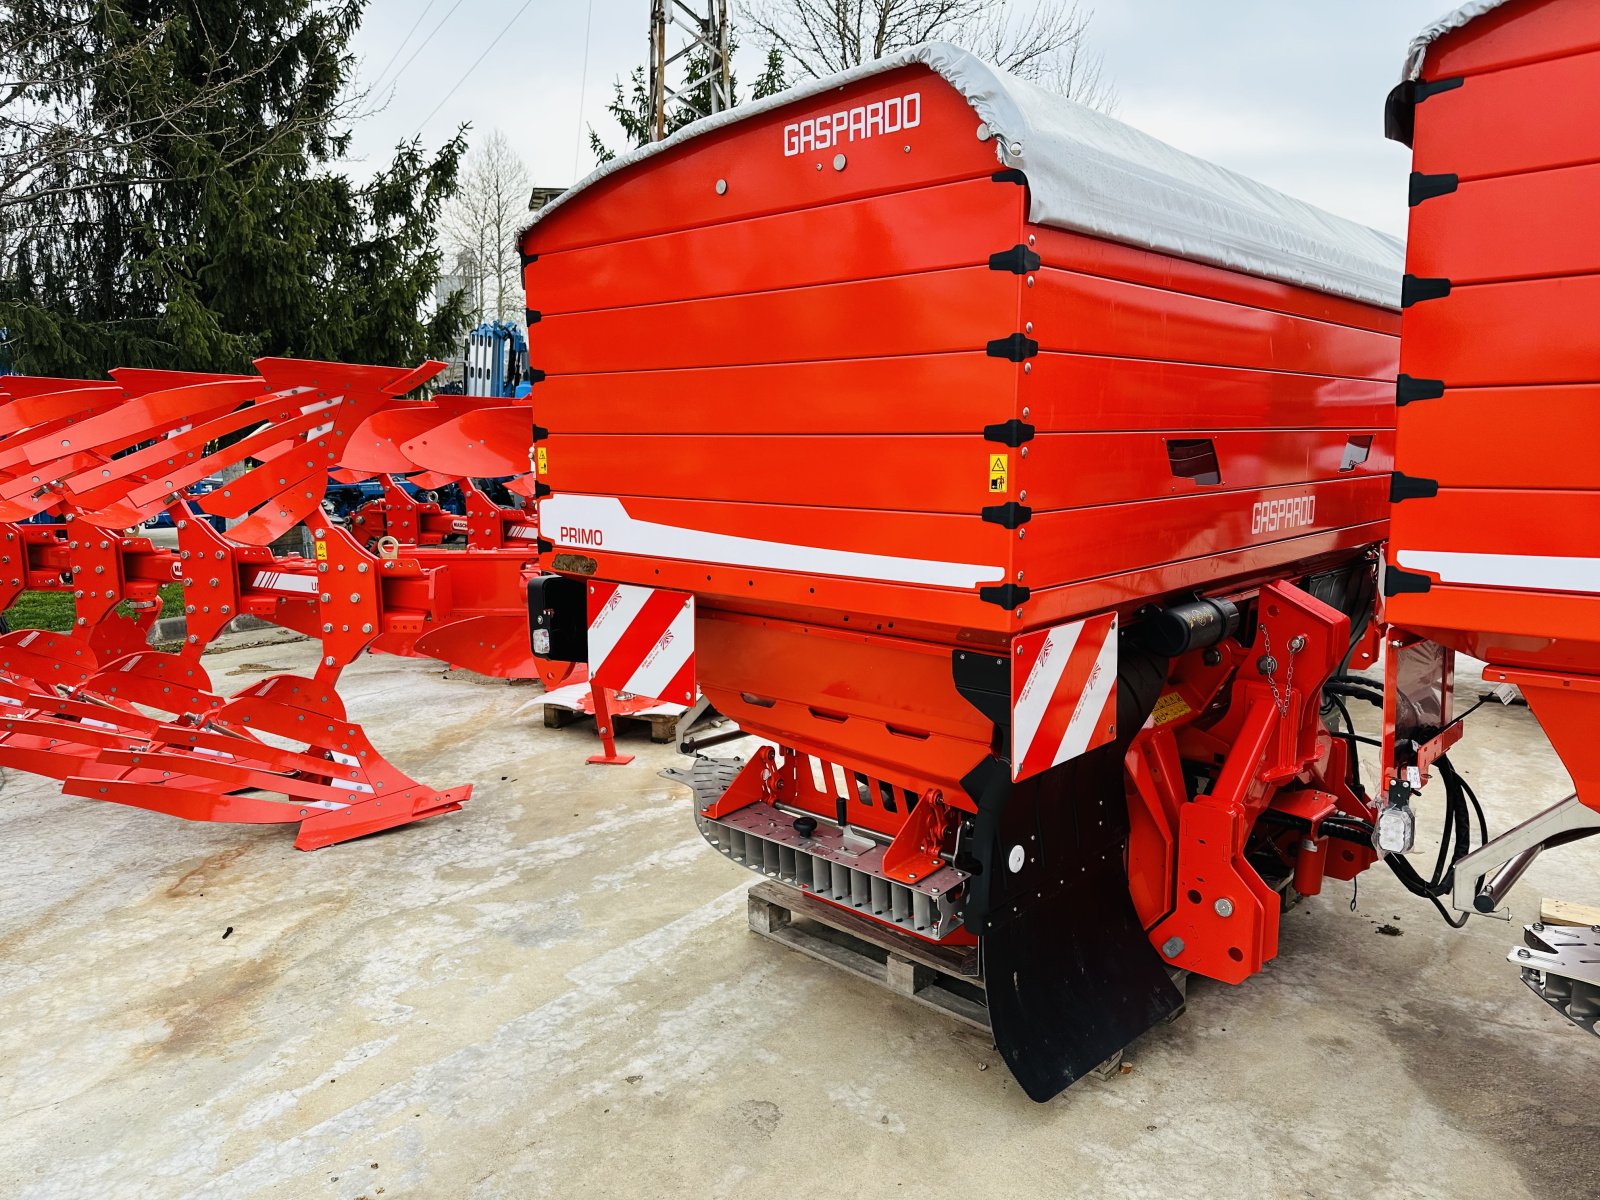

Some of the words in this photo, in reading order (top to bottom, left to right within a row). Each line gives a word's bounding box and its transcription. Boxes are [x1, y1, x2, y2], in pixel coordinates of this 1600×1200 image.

[784, 92, 921, 157] GASPARDO
[1251, 495, 1316, 535] GASPARDO
[560, 526, 603, 546] PRIMO
